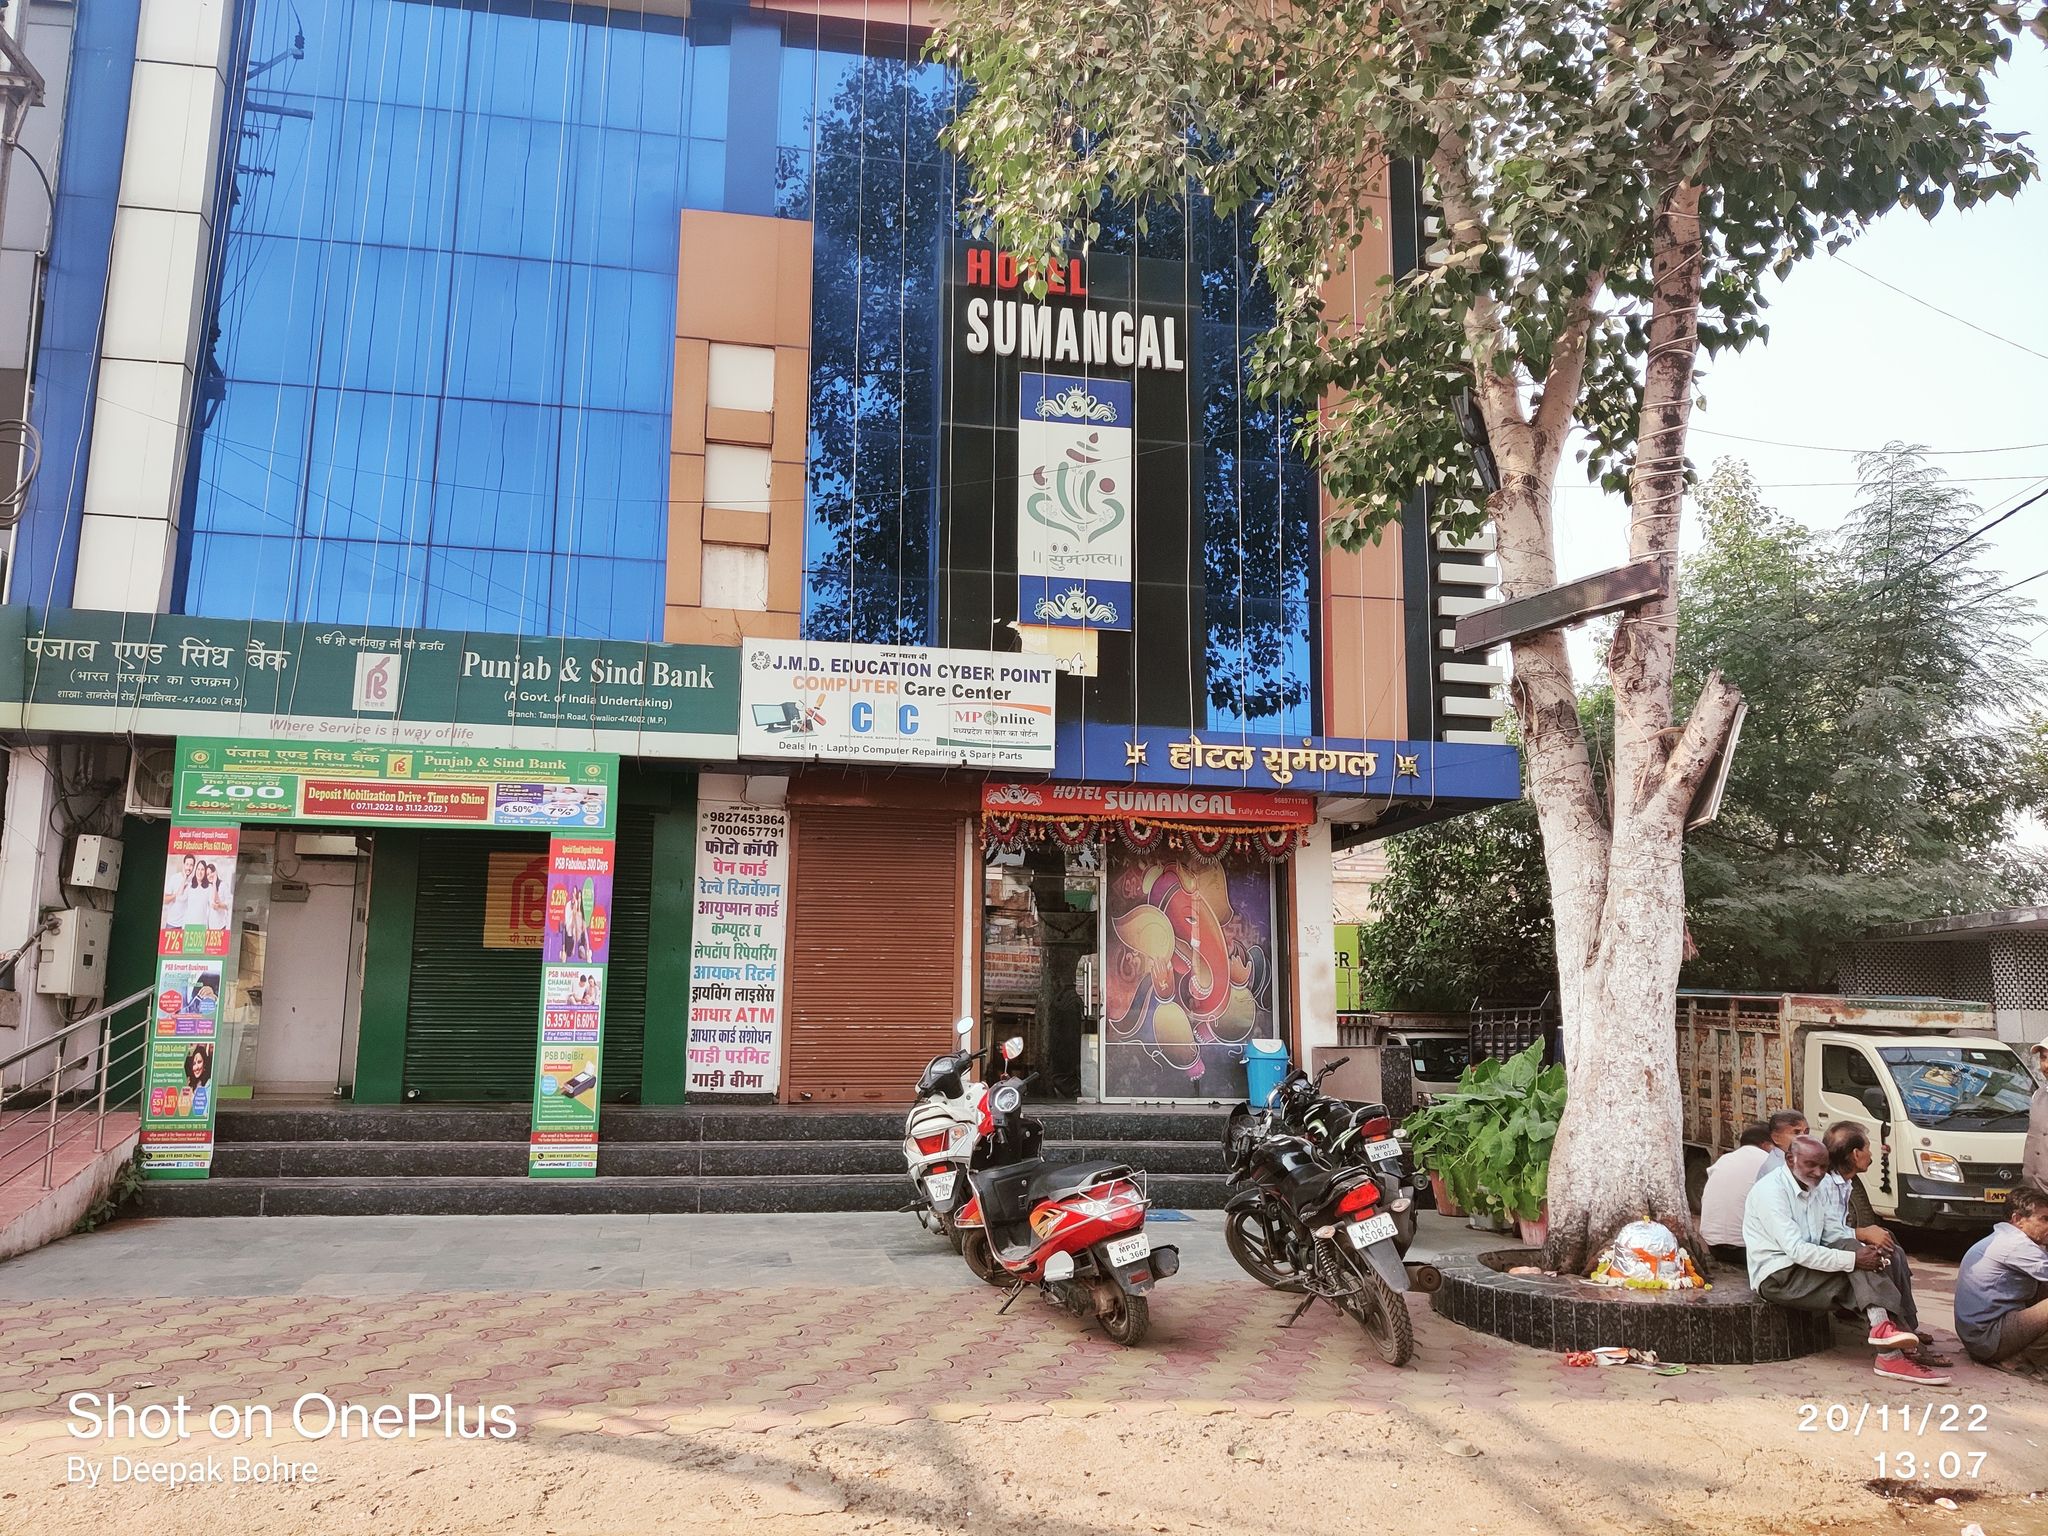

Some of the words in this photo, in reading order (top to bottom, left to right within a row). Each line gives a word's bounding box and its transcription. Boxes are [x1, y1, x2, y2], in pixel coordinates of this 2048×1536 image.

[967, 247, 1088, 297] HOEL
[967, 297, 1184, 372] SUMANGAL
[26, 630, 101, 662] पंजाब
[111, 641, 168, 670] एण्ड
[178, 636, 235, 669] सिंध
[245, 639, 292, 671] बैंक
[116, 673, 160, 685] सरकार
[167, 675, 184, 686] का
[462, 652, 552, 686] Punjab
[560, 656, 583, 682] &
[590, 658, 645, 686] Sind
[652, 661, 715, 689] Bank
[773, 656, 825, 673] J.M.D.
[831, 658, 932, 678] EDUCATION
[937, 664, 995, 682] CYBER
[1000, 668, 1052, 684] POINT
[792, 675, 898, 695] COMPUTER
[904, 681, 946, 698] Care
[952, 684, 1012, 701] Center
[520, 691, 550, 702] Govt.
[554, 694, 565, 703] of
[569, 694, 597, 704] India
[600, 695, 673, 710] Undertaking)
[539, 712, 565, 720] Tansen
[269, 719, 315, 732] Where
[318, 721, 371, 736] Service
[375, 723, 387, 736] is
[392, 728, 400, 736] a
[404, 728, 431, 741] way
[435, 728, 453, 739] of
[453, 729, 474, 740] life
[224, 745, 270, 759] पंजाब
[275, 750, 308, 761] एण्ड
[313, 748, 347, 761] सिंध
[351, 750, 381, 763] बैंक
[779, 741, 805, 751] Deals
[808, 743, 818, 751] In
[826, 743, 860, 754] Laptop
[862, 745, 909, 756] Computer
[912, 747, 957, 759] Repairing
[960, 749, 967, 758] &
[969, 750, 996, 761] Spare
[999, 751, 1023, 761] Parts
[1168, 733, 1257, 771] होटल
[1261, 737, 1379, 784] सुमंगल
[424, 755, 473, 768] Punjab
[476, 757, 489, 767] &
[493, 757, 524, 769] Sind
[529, 759, 567, 769] Bank
[196, 784, 285, 799] 400
[308, 787, 341, 801] Deposit
[342, 788, 396, 802] Mobilization
[398, 790, 422, 803] Drive
[427, 791, 449, 804] Time
[450, 793, 459, 804] to
[460, 793, 485, 805] Shine
[1052, 785, 1102, 800] HOTEL
[1104, 790, 1236, 816] SUMANGAL
[356, 802, 394, 811] 07.11.2022
[395, 804, 403, 812] to
[405, 804, 443, 813] 31.12.2022
[1238, 807, 1254, 816] Fully
[1254, 808, 1264, 816] Air
[1265, 808, 1299, 818] Condition
[710, 811, 785, 826] 9827453864
[710, 824, 784, 838] 7000657791
[183, 841, 204, 850] Fabulous
[705, 837, 740, 855] फोटो
[743, 839, 779, 857] कॉपी
[555, 857, 566, 870] PSB
[565, 857, 587, 871] Fabulous
[713, 857, 737, 875] पेन
[739, 859, 768, 876] कार्ड
[698, 876, 725, 895] रेल्वे
[727, 878, 782, 897] रिजर्वेशन
[698, 901, 752, 920] आयुष्मान
[755, 900, 780, 917] कार्ड
[754, 924, 763, 938] व
[694, 940, 732, 959] लेपटॉप
[548, 970, 559, 978] PSB
[693, 965, 742, 980] आयकर
[745, 963, 777, 981] रिटर्न
[734, 984, 776, 1003] लाइसेंस
[691, 1007, 732, 1022] आधार
[735, 1007, 775, 1023] ATM
[690, 1028, 716, 1043] आधार
[718, 1025, 737, 1044] कार्ड
[738, 1026, 772, 1045] संशोधन
[544, 1051, 559, 1060] PSB
[725, 1046, 771, 1065] परमिट
[730, 1070, 764, 1088] बीमा
